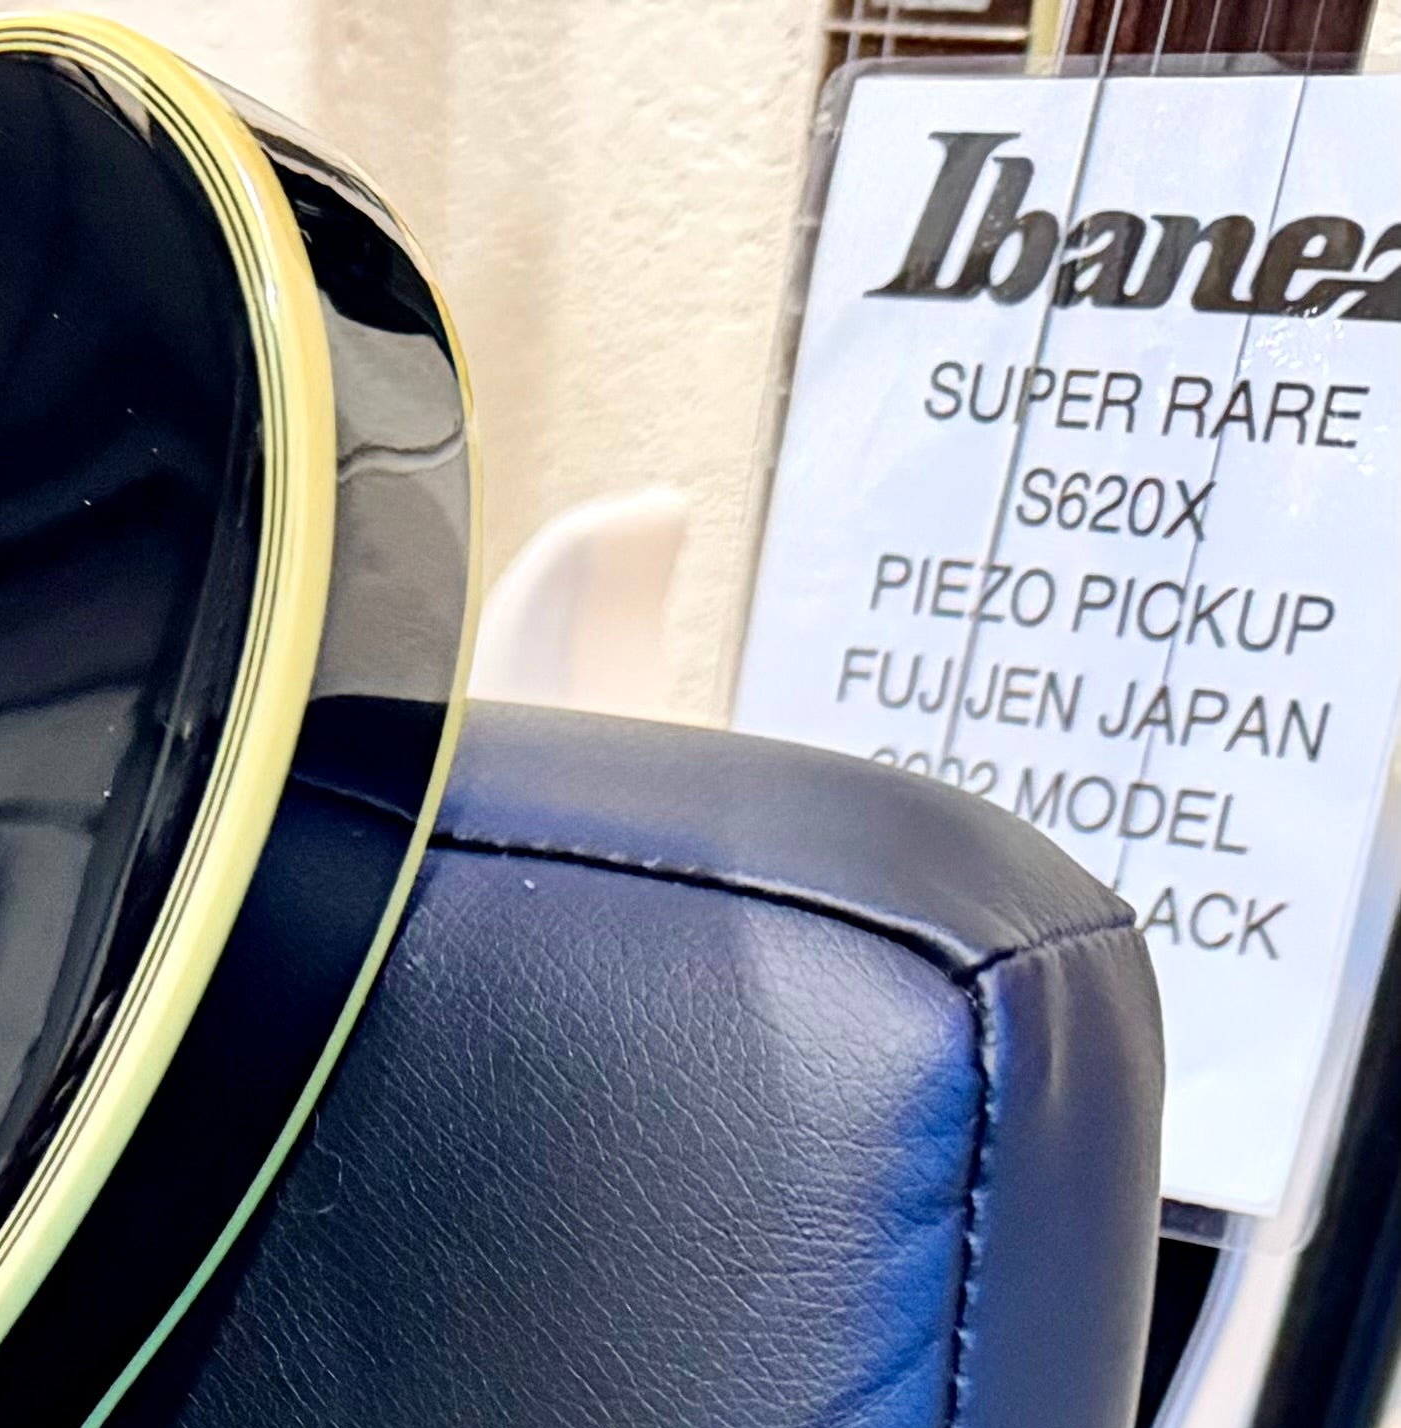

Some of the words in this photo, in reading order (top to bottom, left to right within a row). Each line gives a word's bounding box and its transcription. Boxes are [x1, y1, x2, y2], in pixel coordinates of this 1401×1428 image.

[924, 361, 1142, 434] SUPER
[1162, 375, 1371, 448] RARE
[1015, 468, 1216, 541] S620X
[869, 553, 1057, 627] PIEZO
[1071, 572, 1336, 656] PICKUP
[1099, 679, 1331, 764] JAPAN
[1011, 765, 1250, 855] MODEL
